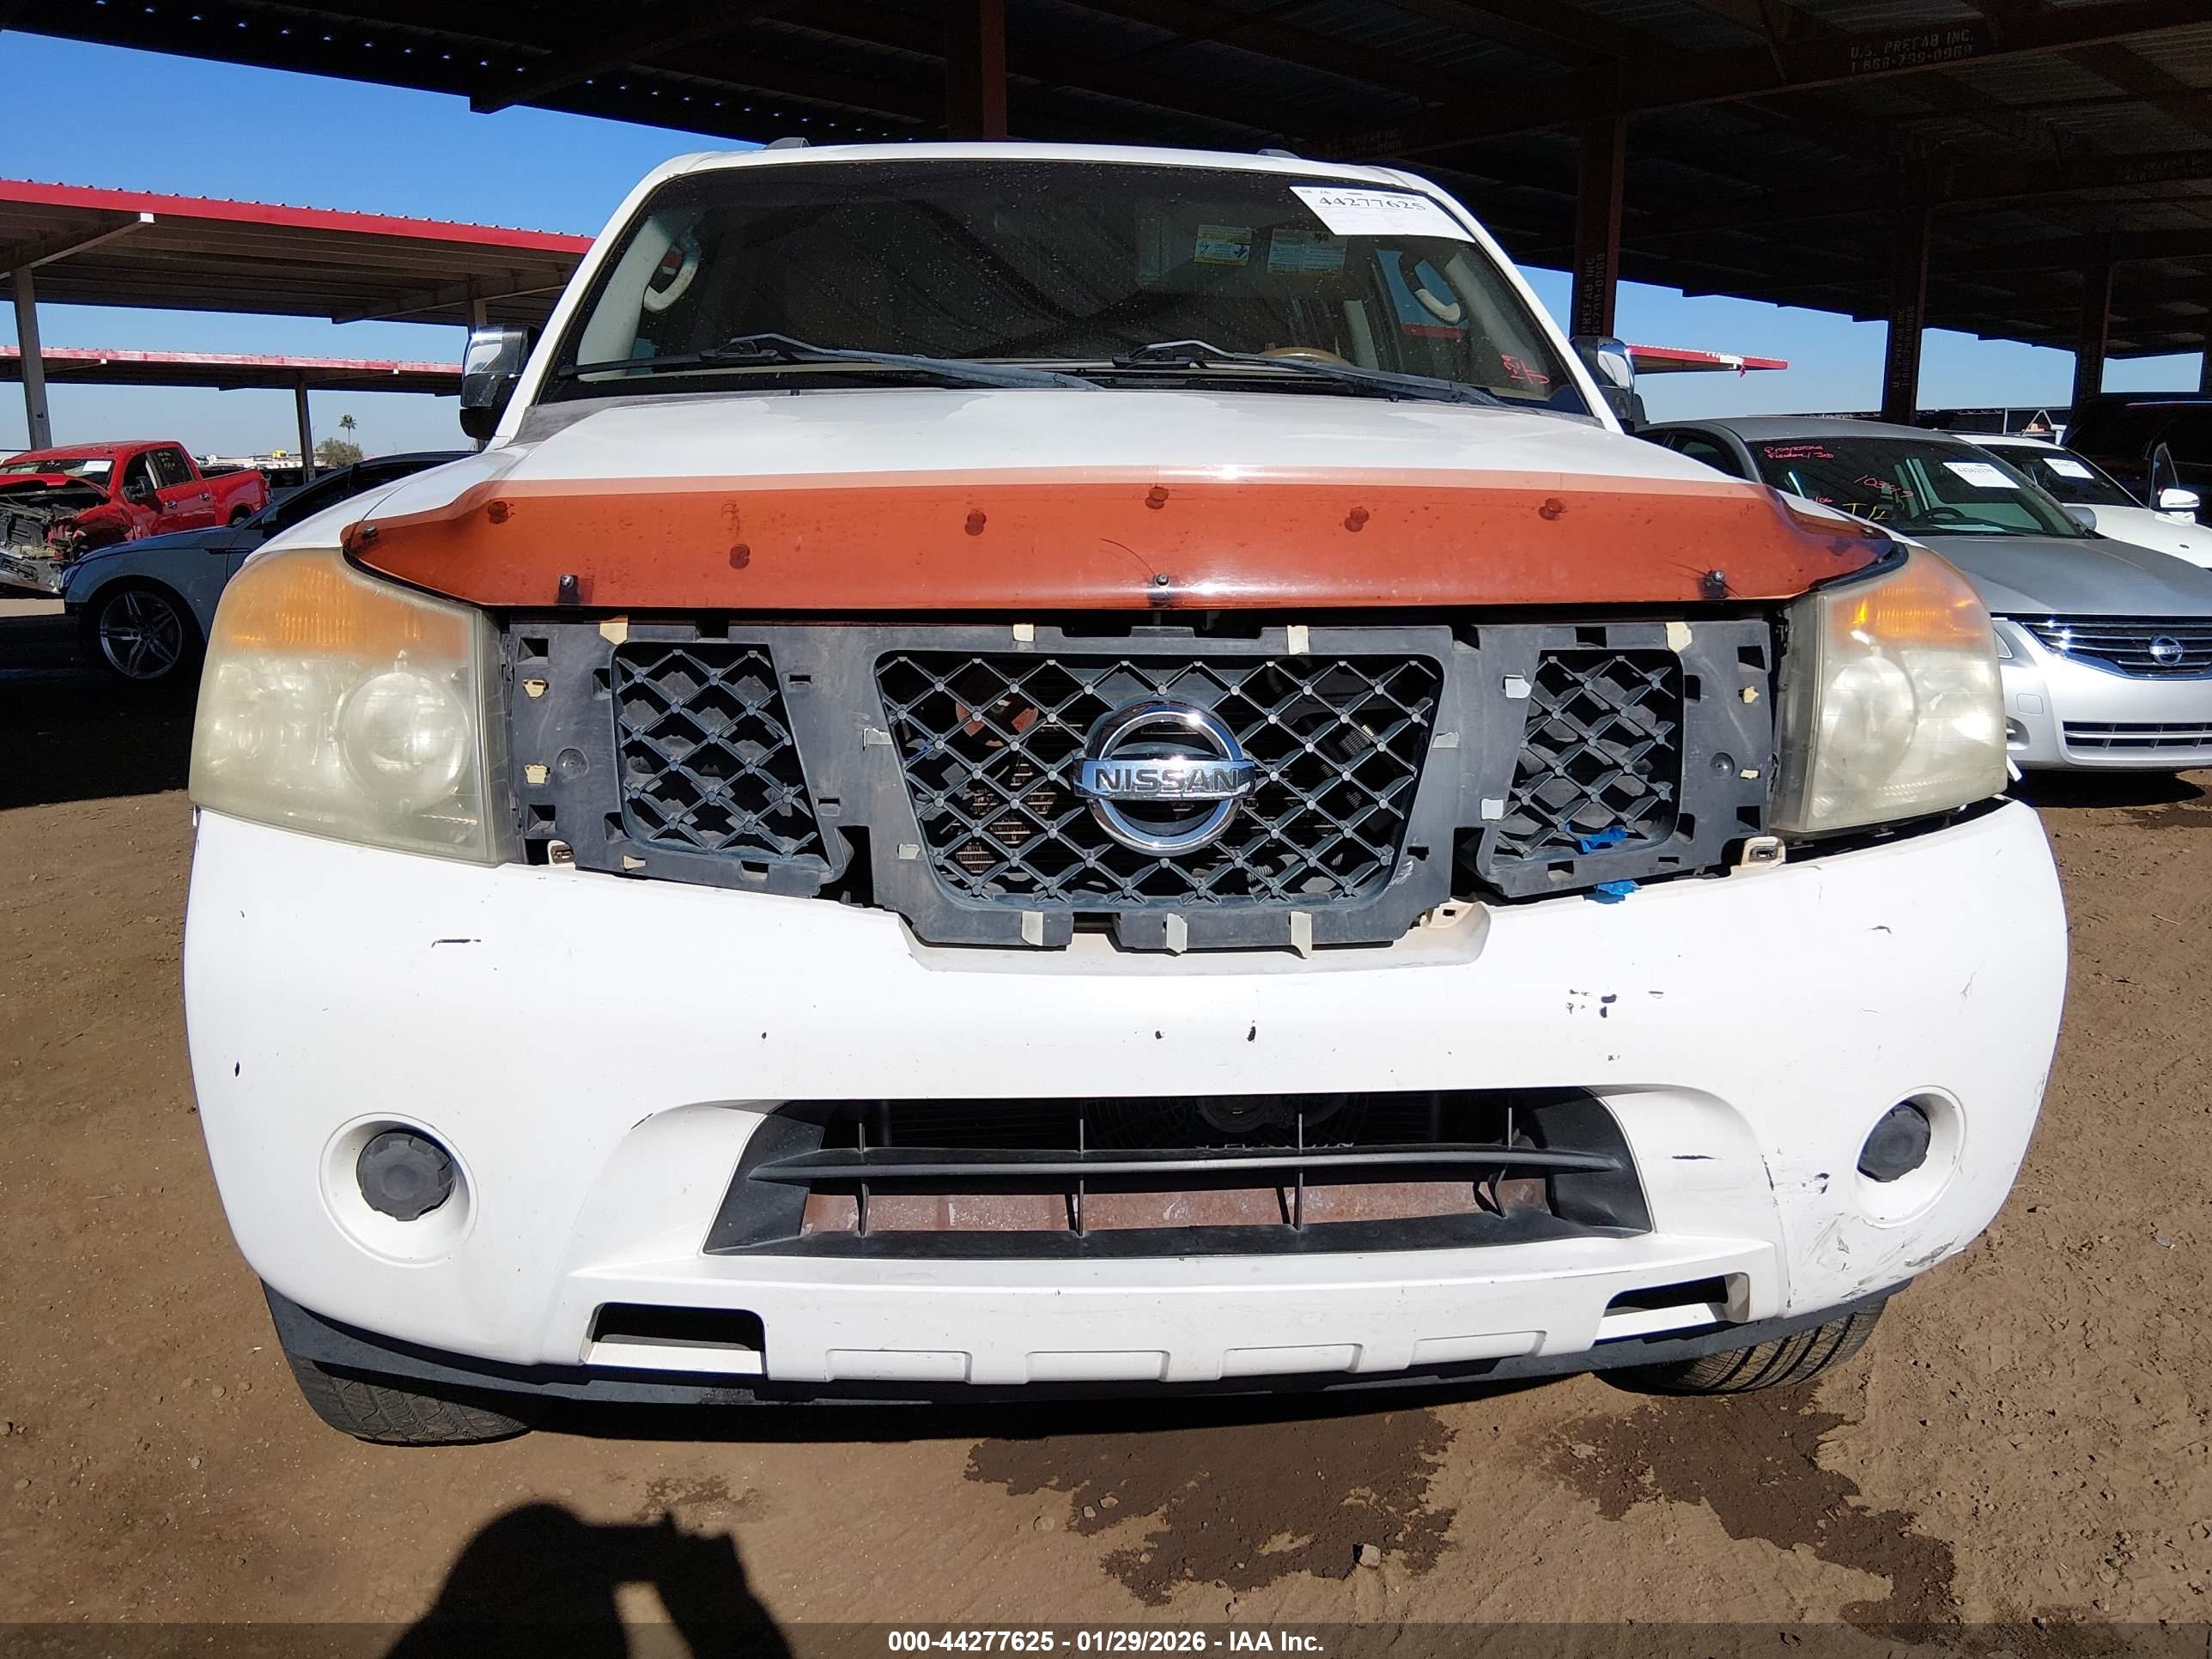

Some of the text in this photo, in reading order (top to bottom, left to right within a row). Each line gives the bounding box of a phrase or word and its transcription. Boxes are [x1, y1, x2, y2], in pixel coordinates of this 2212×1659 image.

[1850, 44, 1876, 58] U.S.
[1884, 33, 1939, 54] PREFAB
[1319, 196, 1427, 211] 44277625
[1094, 768, 1239, 793] NISSAN
